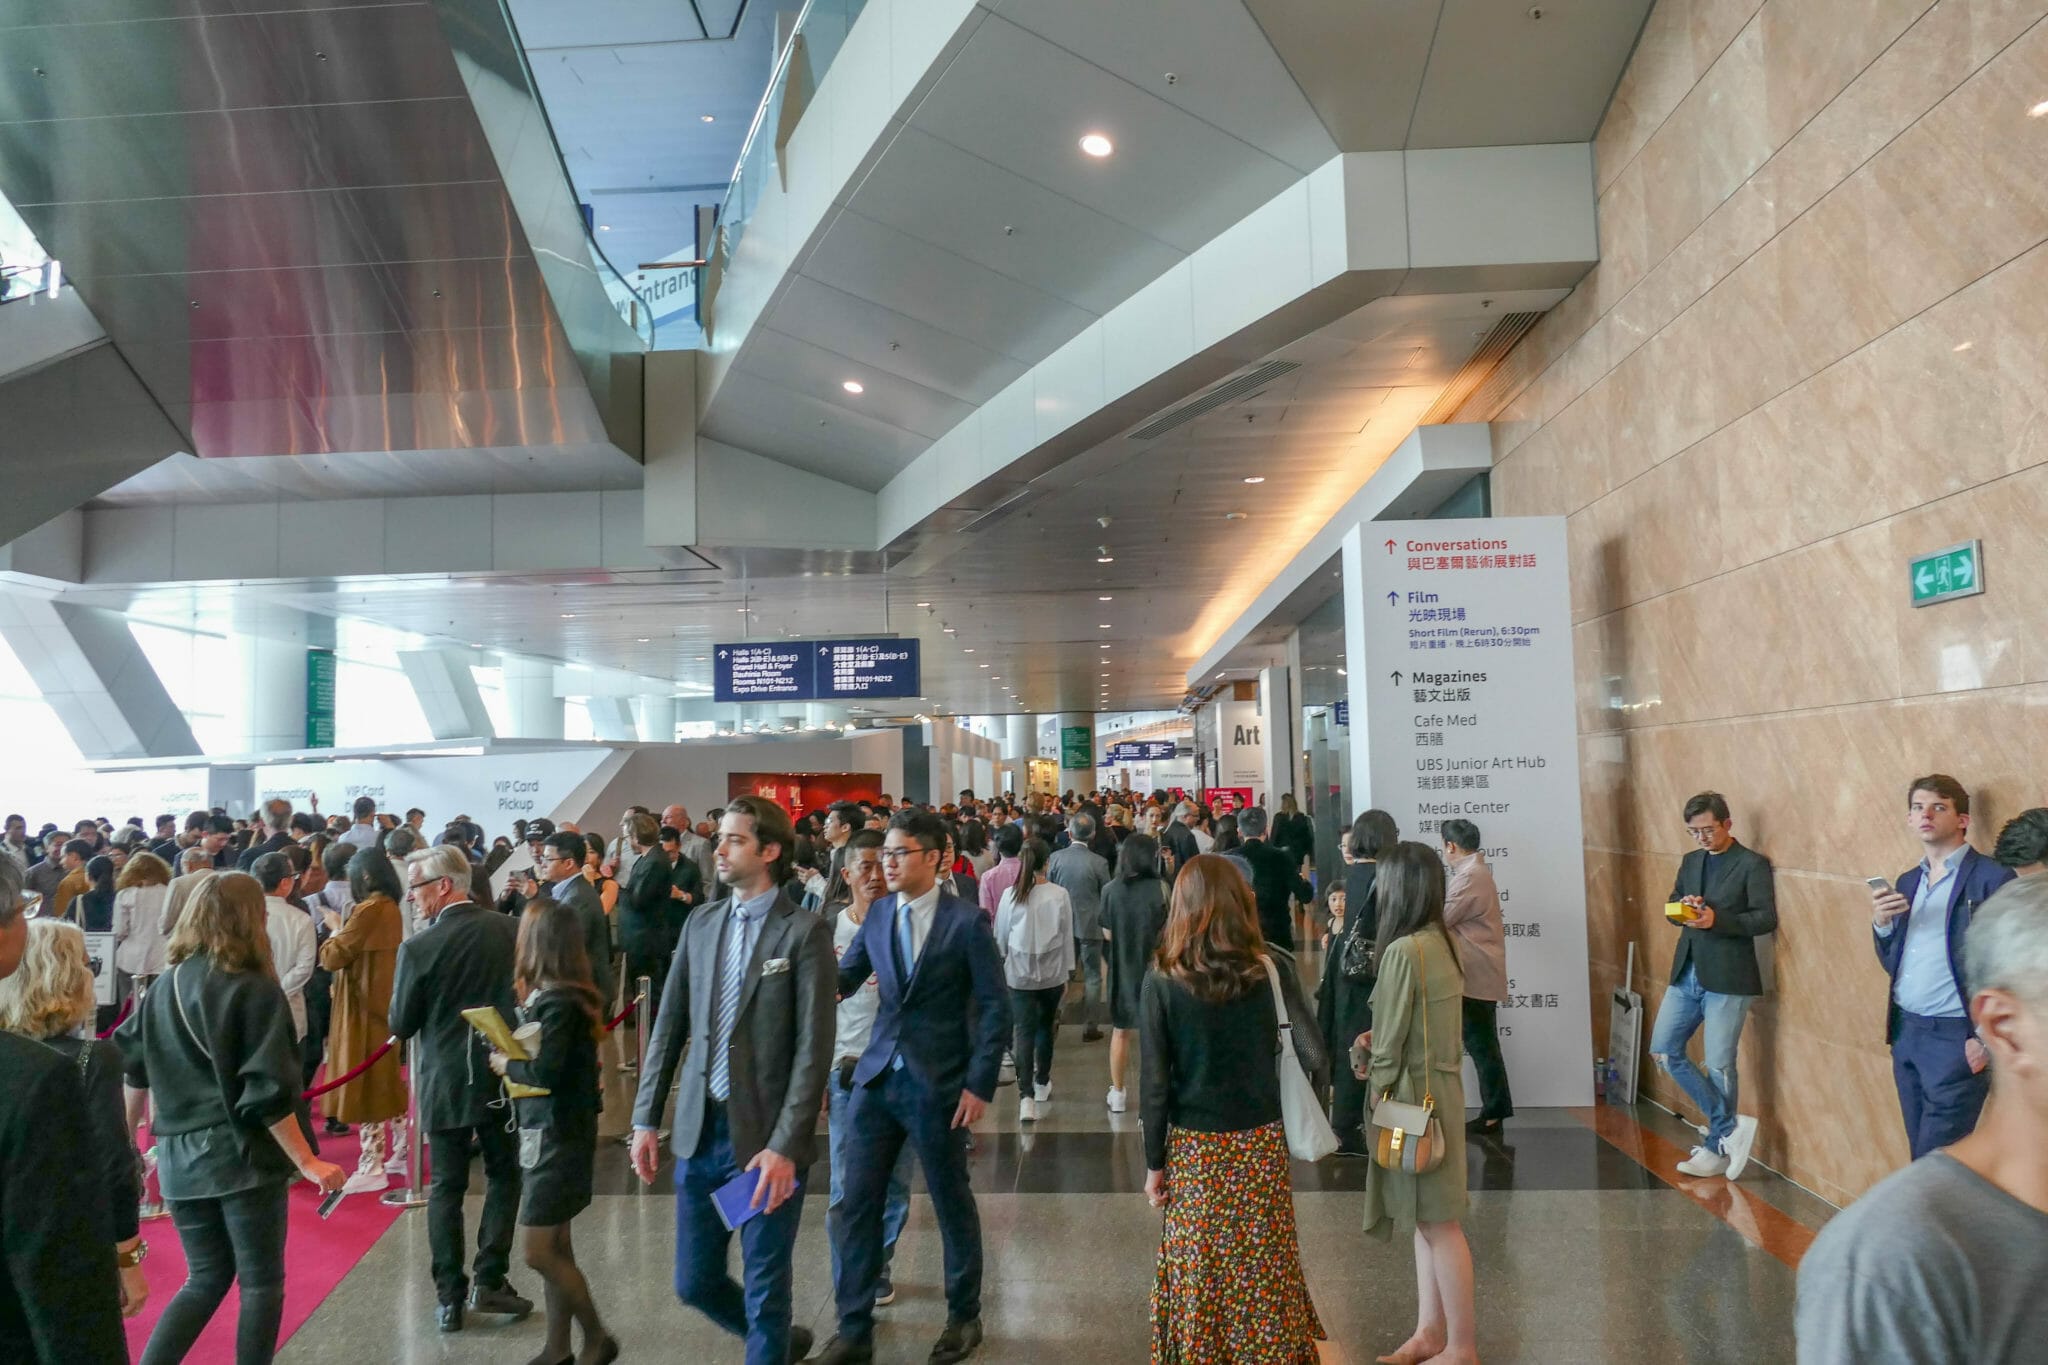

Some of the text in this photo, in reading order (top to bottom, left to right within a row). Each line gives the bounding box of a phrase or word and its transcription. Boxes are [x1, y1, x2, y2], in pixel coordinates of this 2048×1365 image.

[635, 270, 697, 303] ntranc
[1406, 538, 1508, 552] Conversations
[1407, 554, 1537, 571] 與巴塞爾藝術展對話
[1407, 591, 1439, 603] Film
[1408, 607, 1466, 622] 光映現場
[1408, 626, 1540, 638] Short Film (Rerun), 6:30pm
[1413, 670, 1488, 686] Magazines
[1413, 687, 1471, 703] 藝文出版
[1414, 713, 1478, 728] Cafe Med
[1233, 724, 1261, 746] Art
[1415, 731, 1444, 747] 西膳
[1416, 755, 1547, 772] UBS Junior Art Hub
[493, 779, 540, 793] VIP Card
[498, 797, 534, 813] Pickup
[1418, 801, 1511, 815] Media Center
